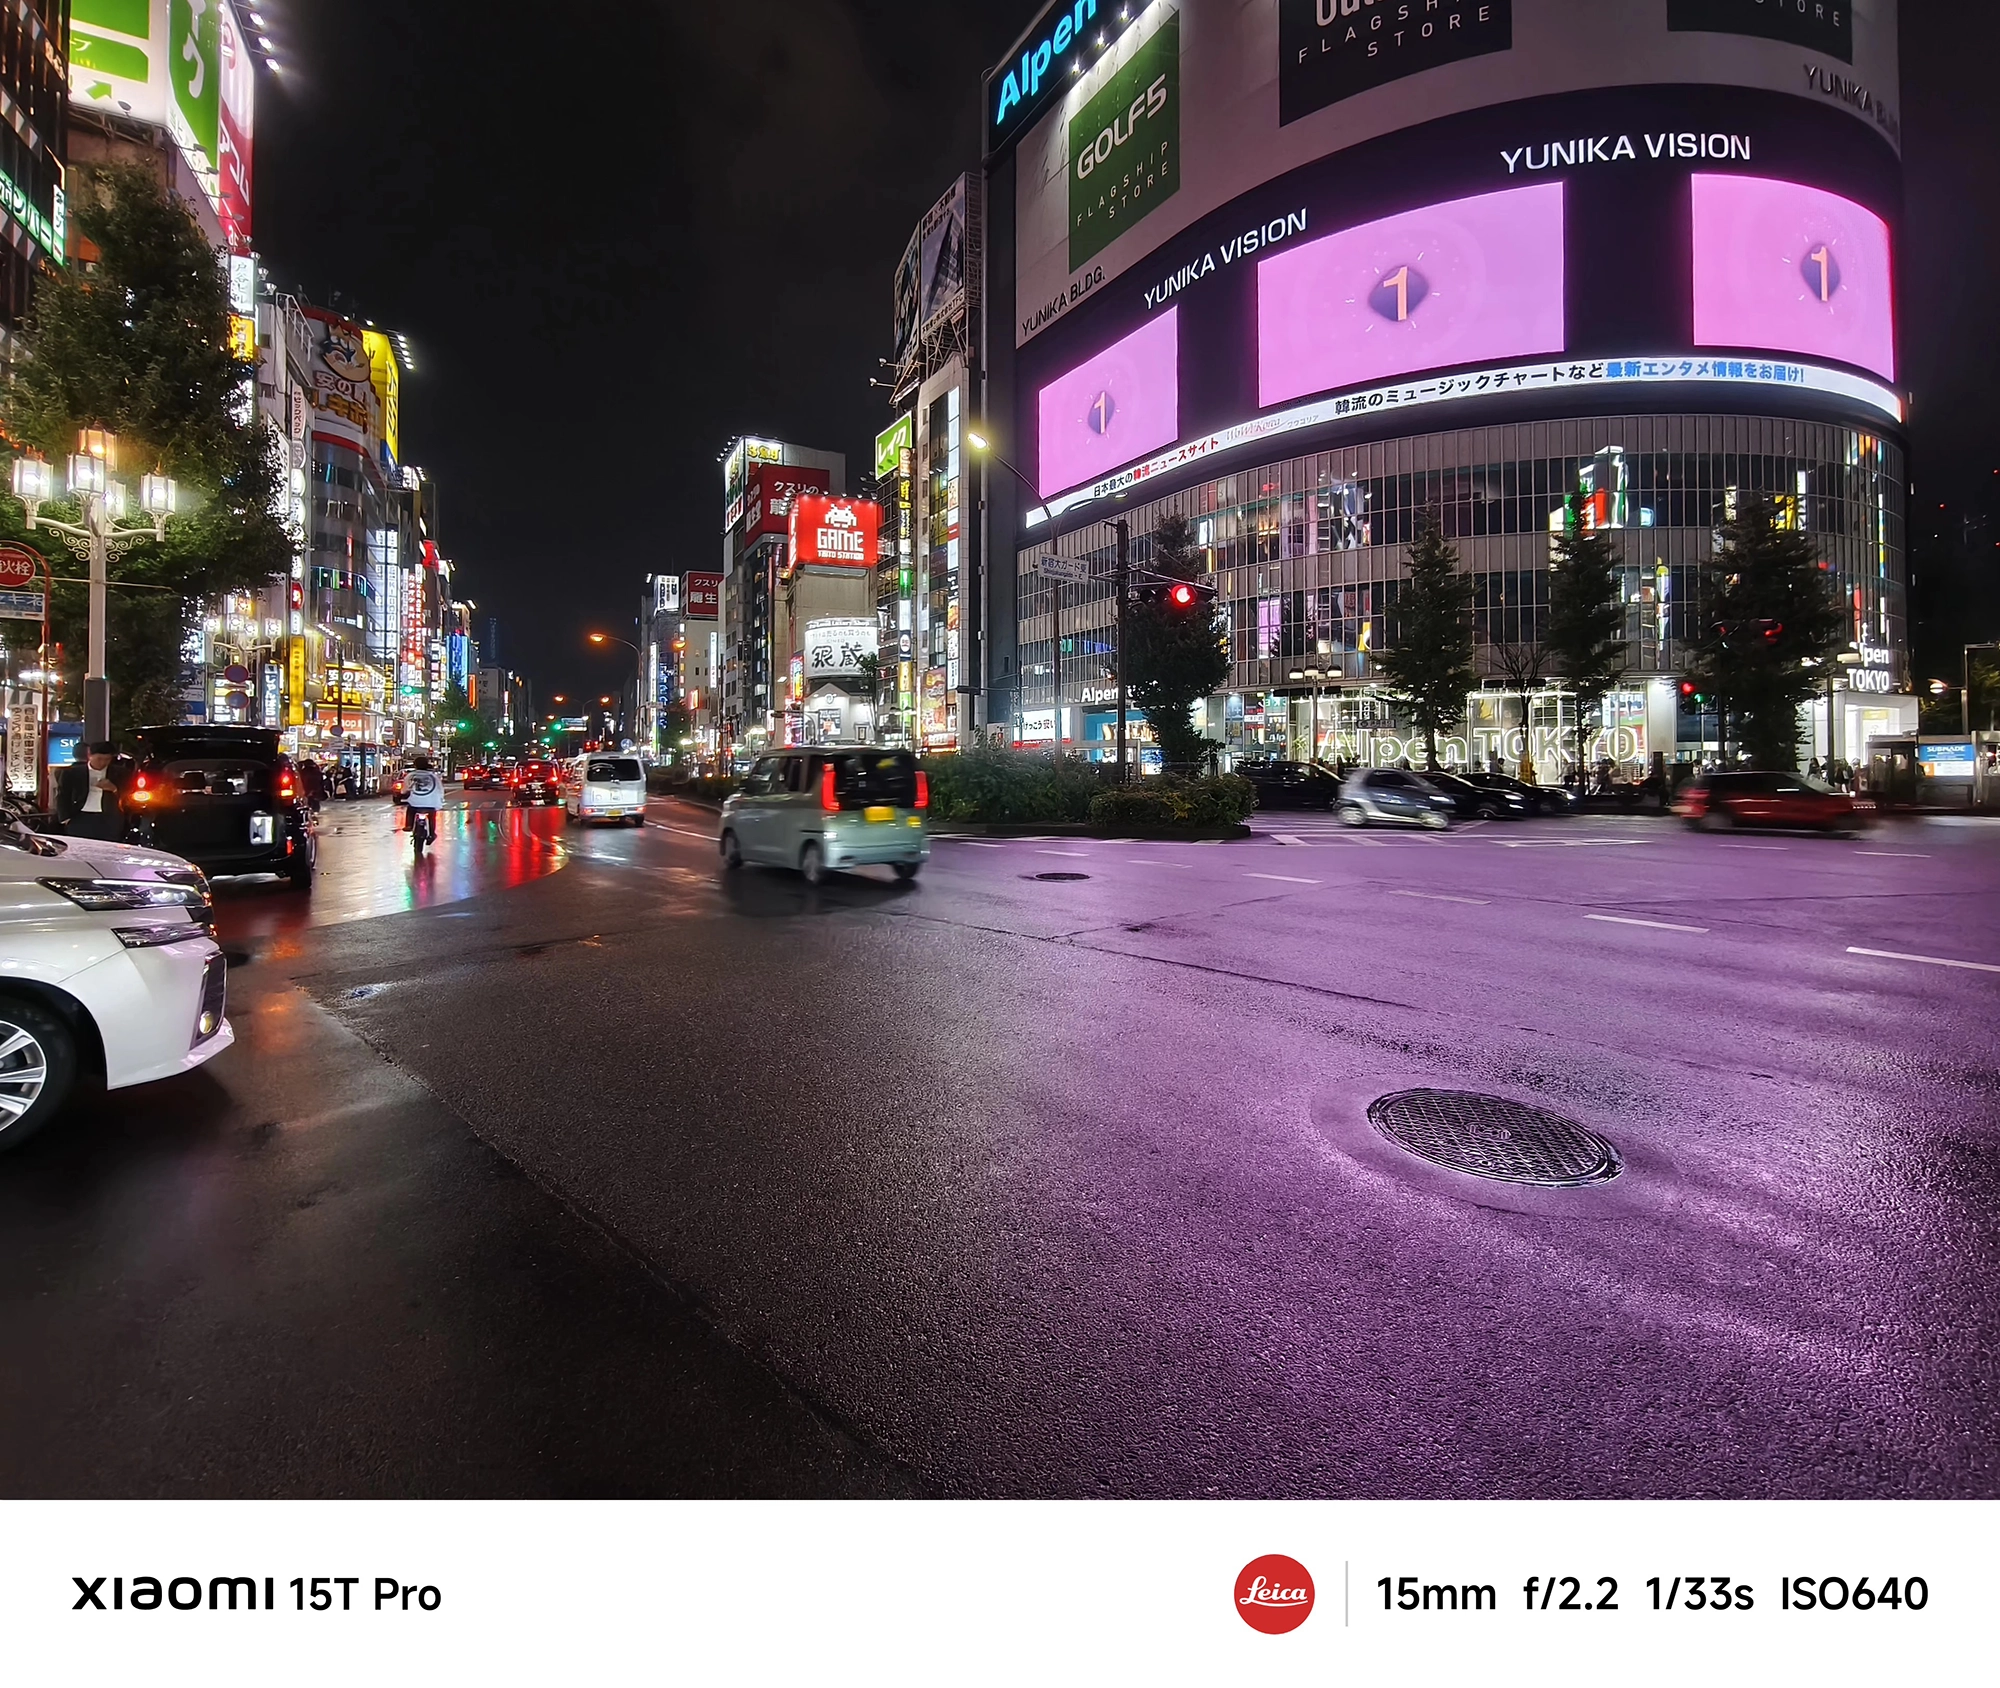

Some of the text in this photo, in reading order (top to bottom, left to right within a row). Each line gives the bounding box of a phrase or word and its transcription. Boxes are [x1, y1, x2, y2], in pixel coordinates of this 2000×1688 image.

[1367, 5, 1490, 57] STORE
[996, 0, 1097, 125] Alpen
[1077, 73, 1167, 180] GOLF5
[1500, 132, 1751, 174] YUNIKA VISION
[1076, 141, 1169, 227] FLAGSHIP
[1108, 162, 1168, 219] STORE
[1144, 208, 1309, 310] YUNIKA VISION
[1811, 246, 1827, 301] 1
[1021, 289, 1068, 337] YUNIKA
[1384, 266, 1407, 321] 1
[1094, 391, 1107, 434] 1
[877, 425, 907, 467] レイク
[1093, 437, 1219, 498] 日本最大の韓流ニュースサイト
[817, 528, 864, 552] GAME
[1846, 668, 1890, 691] TOKYO
